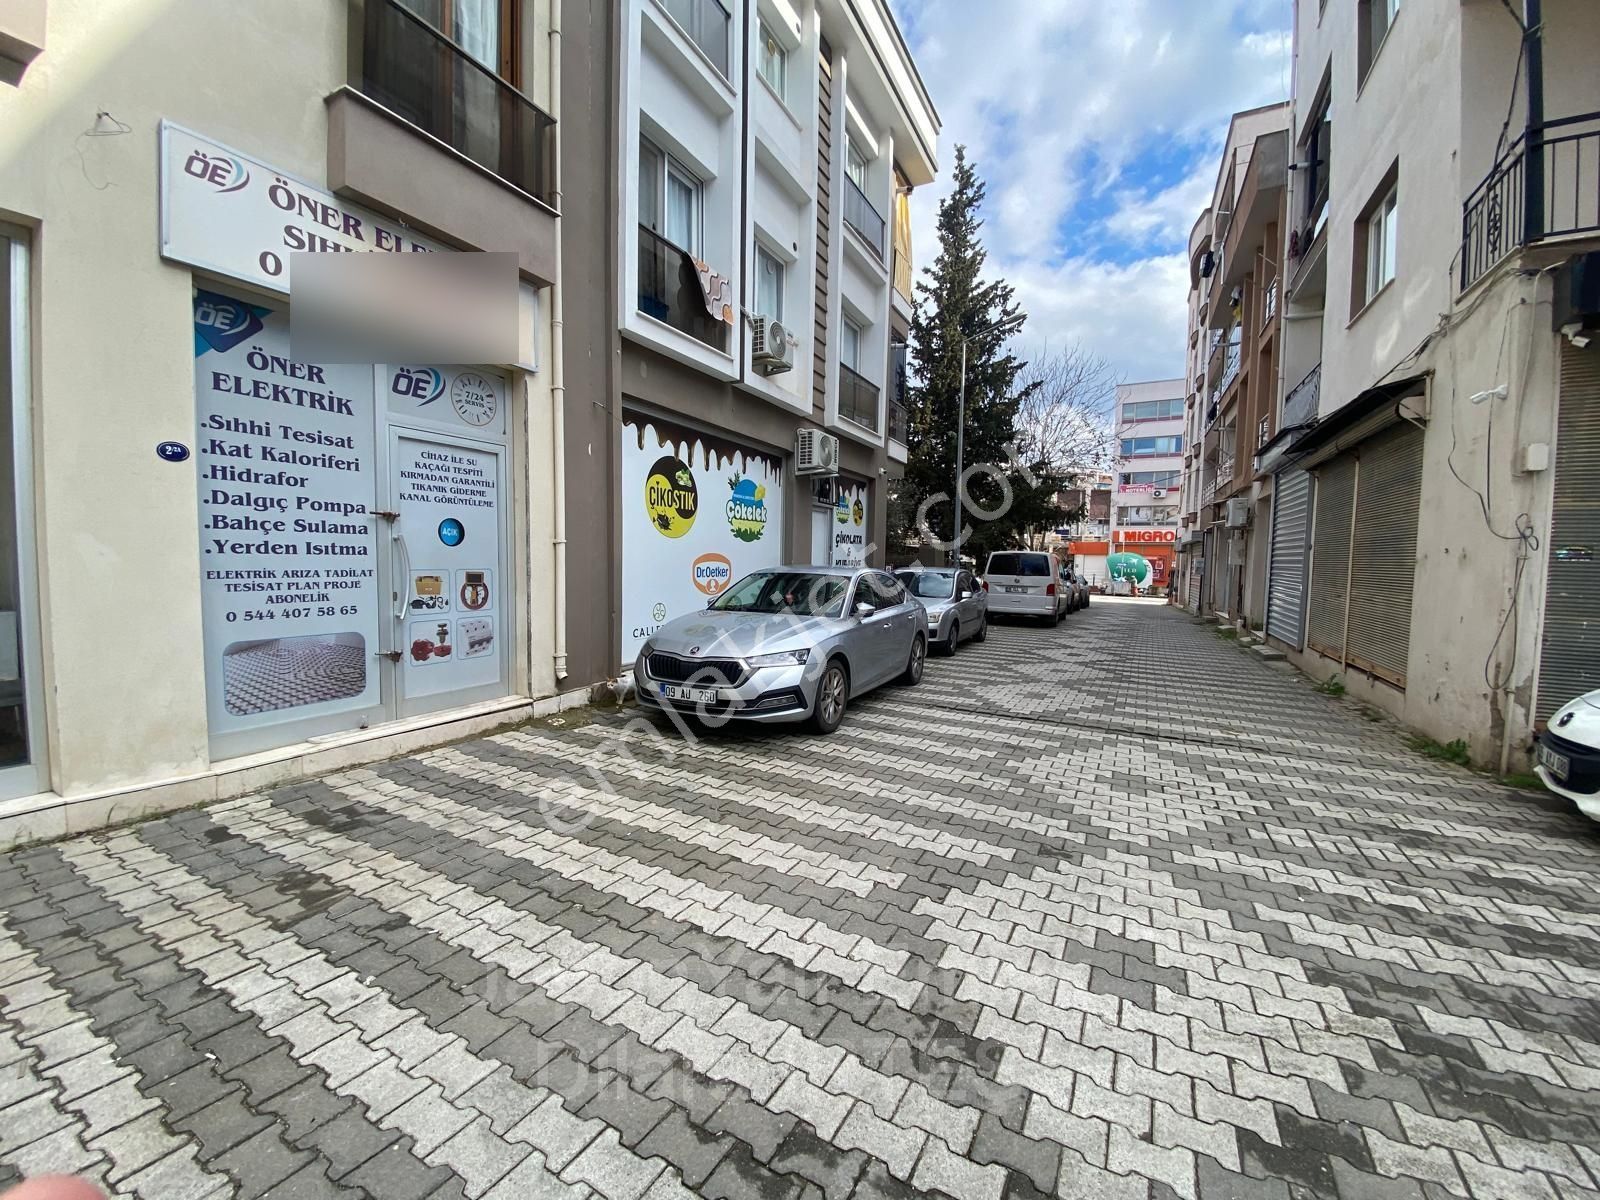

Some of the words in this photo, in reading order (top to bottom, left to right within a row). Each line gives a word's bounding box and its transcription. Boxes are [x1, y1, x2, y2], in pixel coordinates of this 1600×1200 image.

[184, 150, 233, 187] ÖE
[268, 178, 366, 241] ÖNER
[246, 345, 326, 384] ÖNER
[392, 367, 431, 400] ÖE
[211, 371, 354, 416] ELEKTRİK
[465, 391, 485, 402] 7/24
[279, 425, 354, 449] Tesisat
[261, 446, 360, 472] Kaloriferi
[420, 450, 449, 463] CİHAZ
[451, 454, 464, 465] İLE
[466, 458, 478, 467] SU
[415, 461, 451, 474] KAÇAĞI
[453, 466, 483, 477] TESPİTİ
[400, 470, 449, 483] KIRMADAN
[451, 476, 495, 489] GARANTİLİ
[411, 482, 447, 494] TIKANIK
[450, 486, 487, 498] GİDERME
[296, 496, 366, 516] Pompa
[399, 492, 431, 503] KANAL
[434, 495, 494, 508] GÖRÜNTÜLEME
[294, 518, 368, 535] Sulama
[306, 541, 368, 556] Isıtma
[206, 567, 277, 580] ELEKTRİK
[281, 569, 320, 579] ARIZA
[325, 567, 374, 578] TADİLAT
[225, 580, 283, 592] TESİSAT
[287, 581, 320, 591] PLAN
[324, 580, 361, 590] PROJE
[265, 592, 330, 605] ABONELİK
[226, 611, 237, 622] 0
[243, 609, 275, 621] 544
[281, 608, 311, 619] 407
[317, 606, 336, 617] 58
[340, 605, 358, 616] 65
[665, 686, 676, 697] 09
